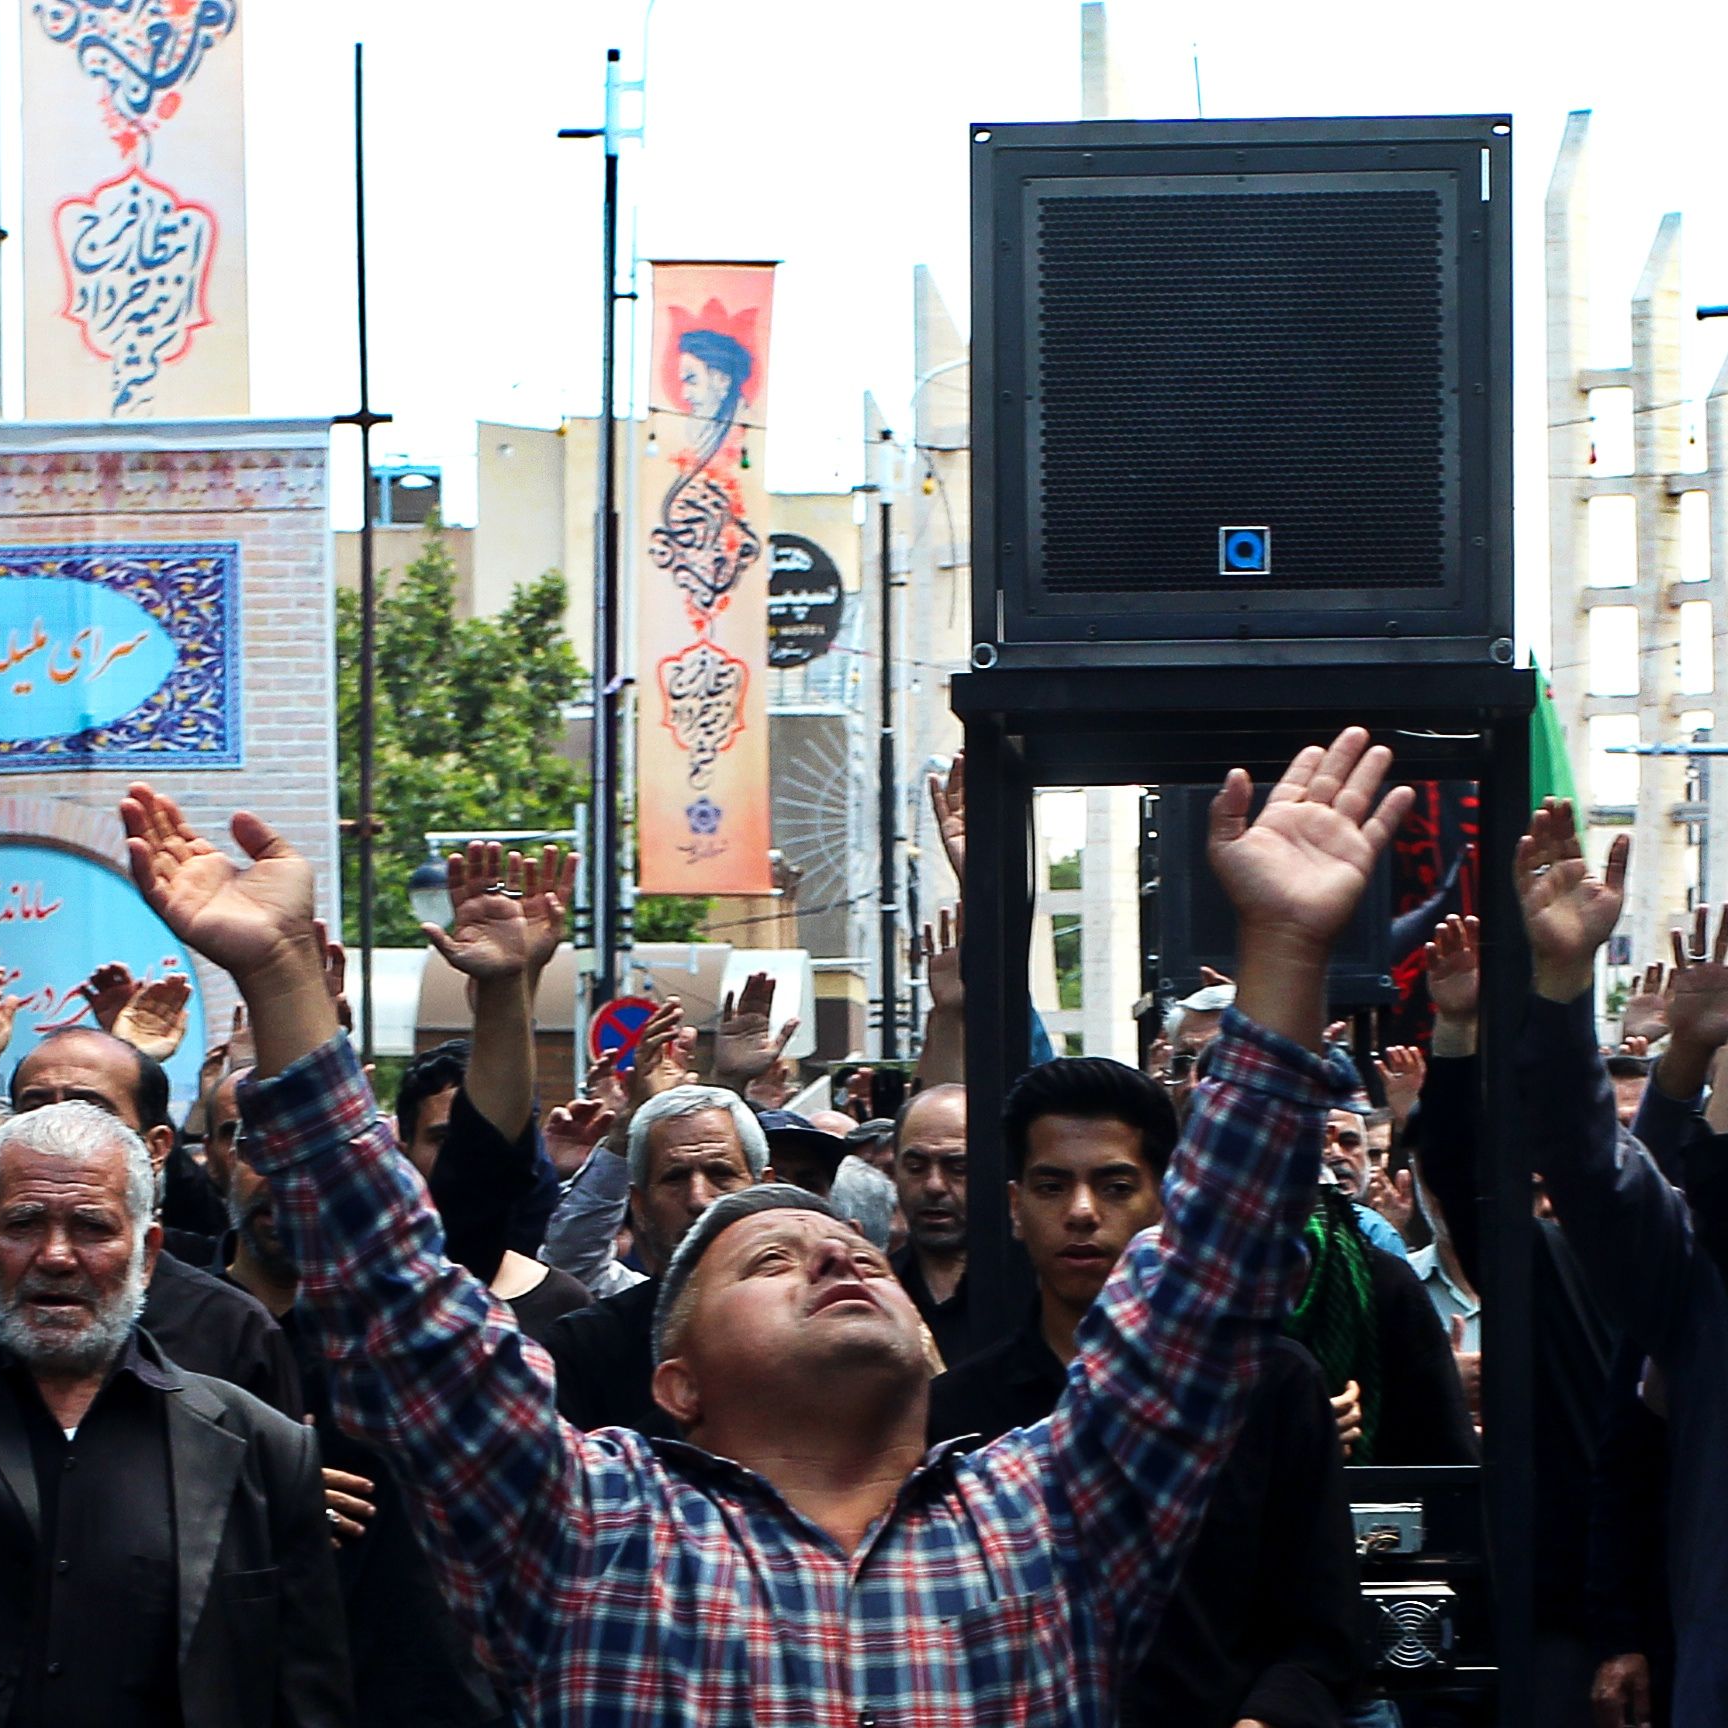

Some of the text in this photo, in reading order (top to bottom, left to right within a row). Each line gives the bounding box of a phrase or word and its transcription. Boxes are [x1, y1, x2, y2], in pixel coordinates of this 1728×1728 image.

[73, 185, 140, 273] فرج
[75, 266, 151, 332] خرداد
[163, 273, 196, 328] از
[49, 627, 150, 685] سرای
